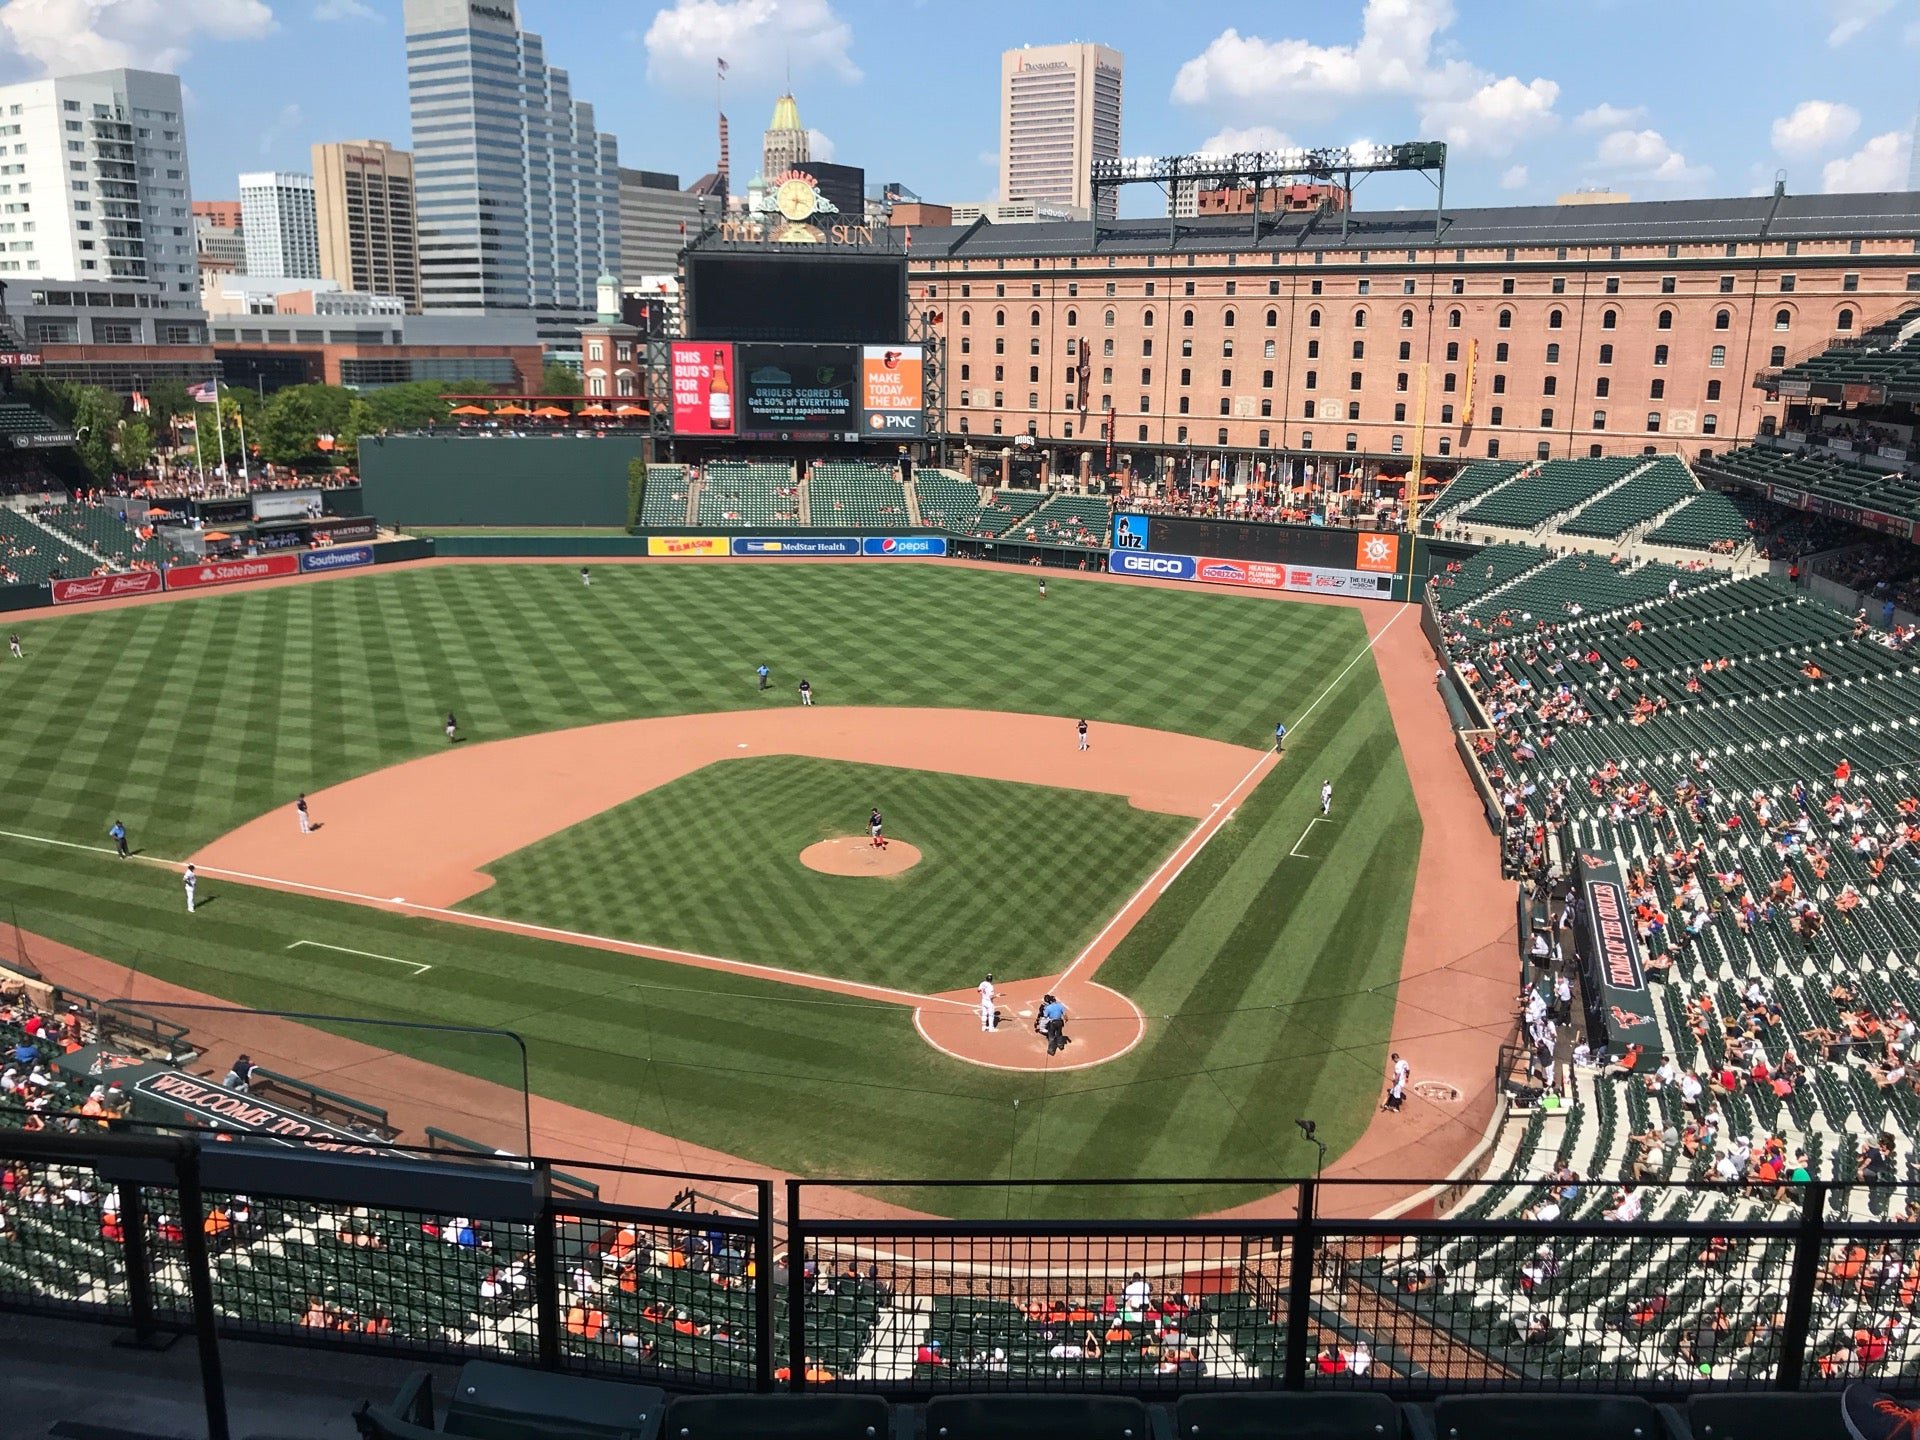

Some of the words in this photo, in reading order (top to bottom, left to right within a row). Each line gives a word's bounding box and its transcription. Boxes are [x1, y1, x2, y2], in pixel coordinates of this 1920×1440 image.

[719, 222, 763, 242] THE
[831, 224, 874, 245] SUN
[674, 351, 701, 363] THIS
[675, 365, 710, 377] BUD'S
[869, 373, 901, 383] MAKE
[675, 379, 698, 390] FOR
[869, 385, 904, 395] TODAY
[756, 388, 793, 398] ORIOLES
[795, 389, 830, 398] SCORED
[675, 393, 702, 405] YOU.
[748, 398, 763, 406] Get
[765, 398, 784, 406] 50%
[786, 398, 797, 406] off
[800, 398, 850, 407] EVERYTHING
[869, 396, 891, 406] THE
[892, 396, 913, 406] DAY
[795, 407, 845, 415] papajohns.com
[886, 416, 916, 428] PNC
[33, 434, 72, 442] Sheraton
[333, 526, 371, 537] HARTFORD
[782, 543, 816, 551] MedStar
[818, 543, 846, 551] Health
[899, 541, 929, 552] pepsi
[308, 552, 360, 567] Southwest
[1124, 556, 1182, 573] GEICO
[1248, 564, 1276, 572] HEATING
[1203, 569, 1245, 579] HORIZON
[1247, 571, 1281, 579] PLUMBING
[1248, 577, 1276, 585] COOLING
[1593, 884, 1620, 920] ORIOLES
[1600, 920, 1625, 939] THE
[1605, 938, 1628, 954] OF
[1607, 954, 1636, 987] HOME
[149, 1074, 278, 1127] WELCOME
[265, 1116, 311, 1138] TO
